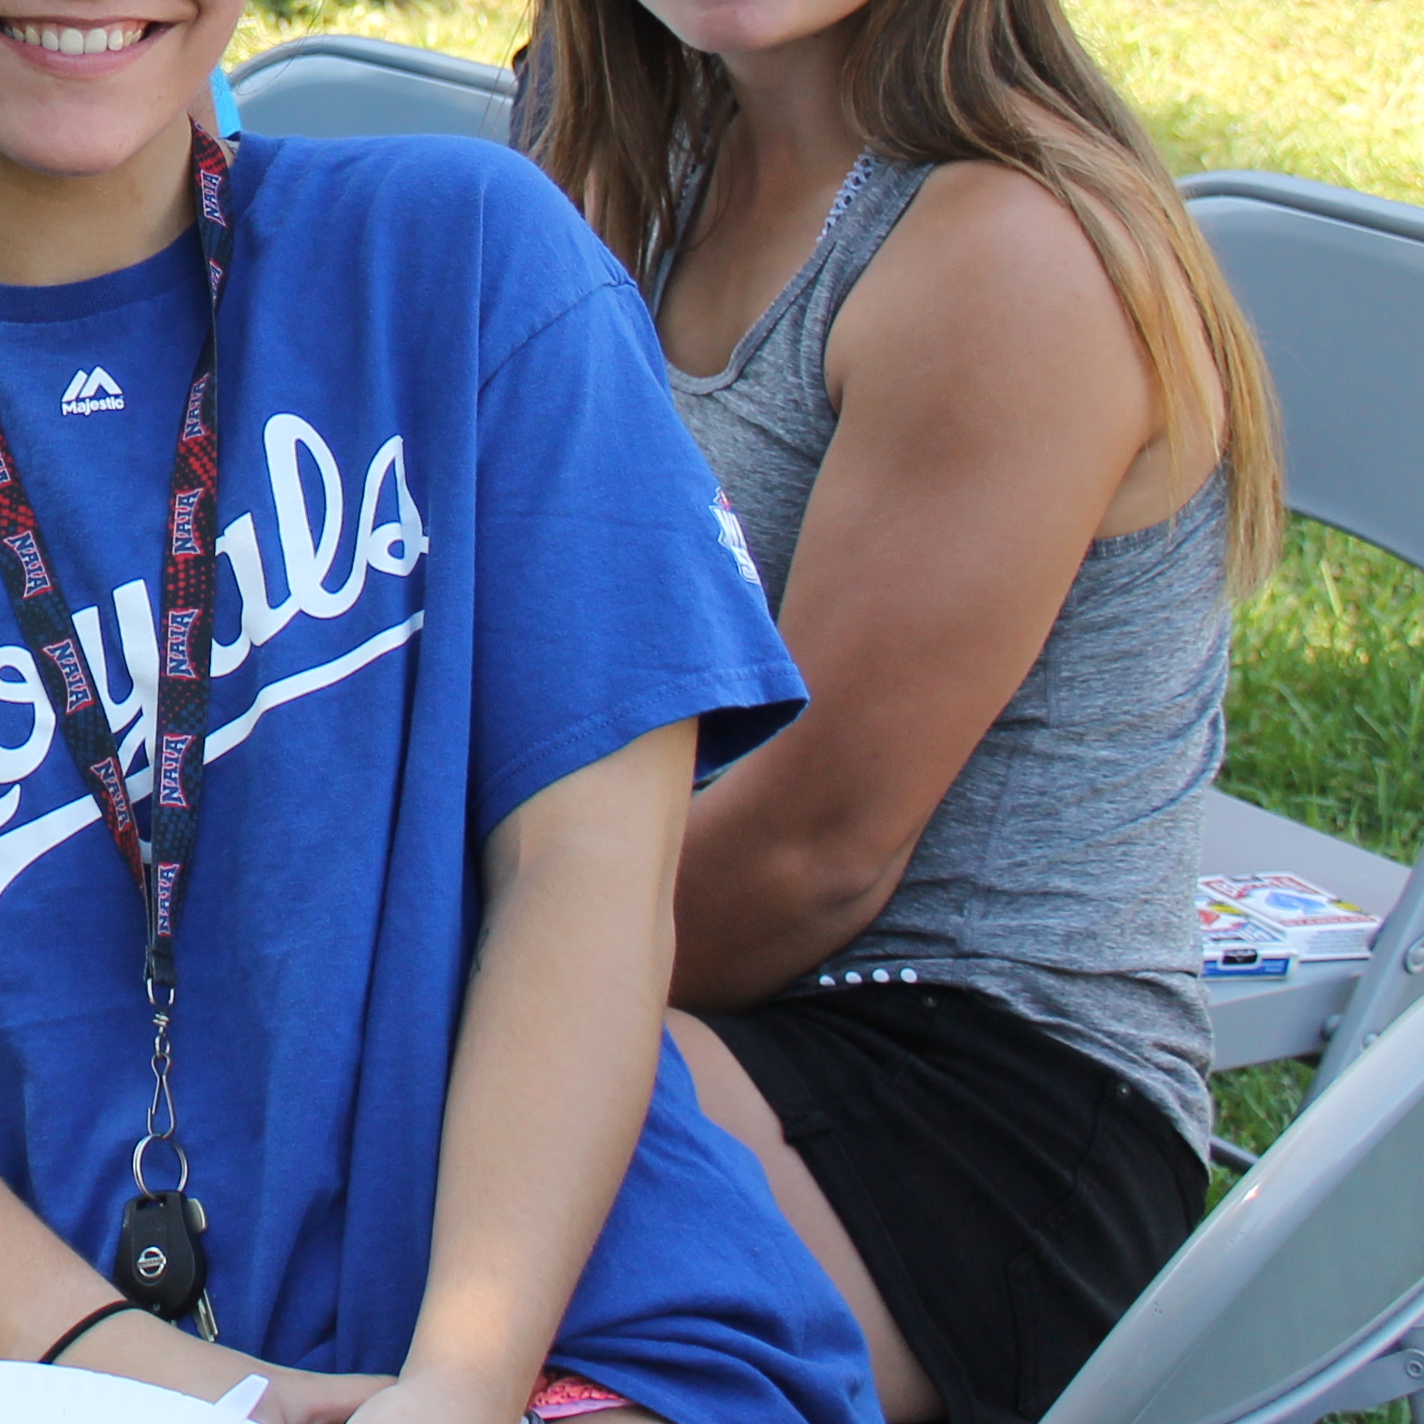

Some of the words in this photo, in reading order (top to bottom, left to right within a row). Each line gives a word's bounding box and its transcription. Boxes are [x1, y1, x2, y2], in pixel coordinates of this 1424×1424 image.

[200, 170, 227, 228] NAIA
[61, 396, 125, 416] Majestic
[183, 373, 210, 442] NAIA
[171, 487, 203, 556] NAIA
[3, 530, 52, 598] NAIA
[43, 639, 94, 714] NAIA
[166, 607, 200, 679] NAIA
[90, 757, 130, 831] NAIA
[159, 733, 194, 808] NAIA
[157, 862, 183, 937] NAIA
